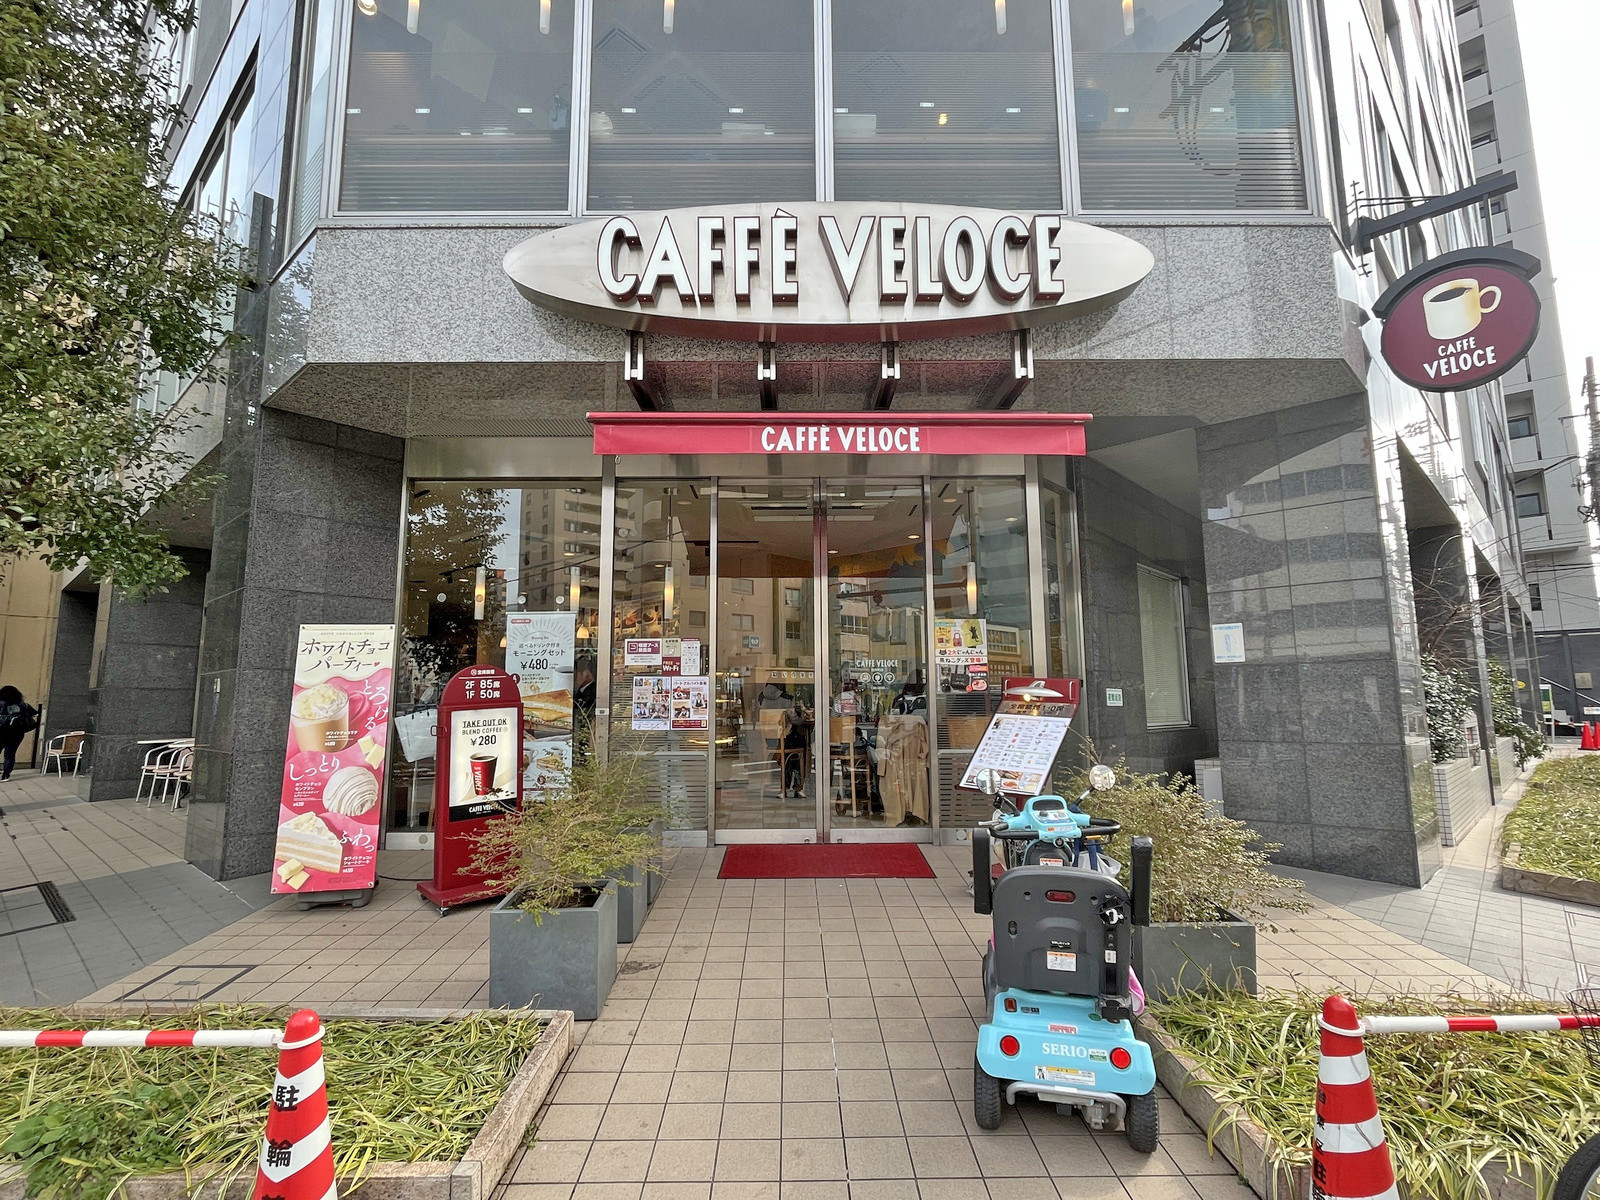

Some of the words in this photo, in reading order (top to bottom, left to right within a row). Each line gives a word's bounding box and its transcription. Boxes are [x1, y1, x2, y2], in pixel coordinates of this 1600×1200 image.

[597, 207, 798, 304] CAFFÈ
[819, 215, 1065, 304] VELOCE
[1423, 345, 1497, 379] VELOCE
[761, 424, 831, 452] CAFFÈ
[836, 426, 920, 452] VELOCE
[301, 638, 391, 656] ホワイトチョコ
[513, 649, 566, 657] モーニングセット
[304, 656, 373, 673] パーティー
[520, 658, 548, 670] ¥480
[465, 680, 475, 689] 2F
[479, 680, 501, 689] 85席
[465, 690, 475, 699] 1F
[479, 690, 501, 699] 50席
[462, 719, 481, 728] TAKE
[482, 719, 496, 727] OUT
[497, 718, 507, 726] OK
[470, 734, 497, 747] ¥280
[289, 754, 340, 781] しっとり
[339, 828, 375, 853] ふわっ
[1042, 1042, 1087, 1058] SERIO
